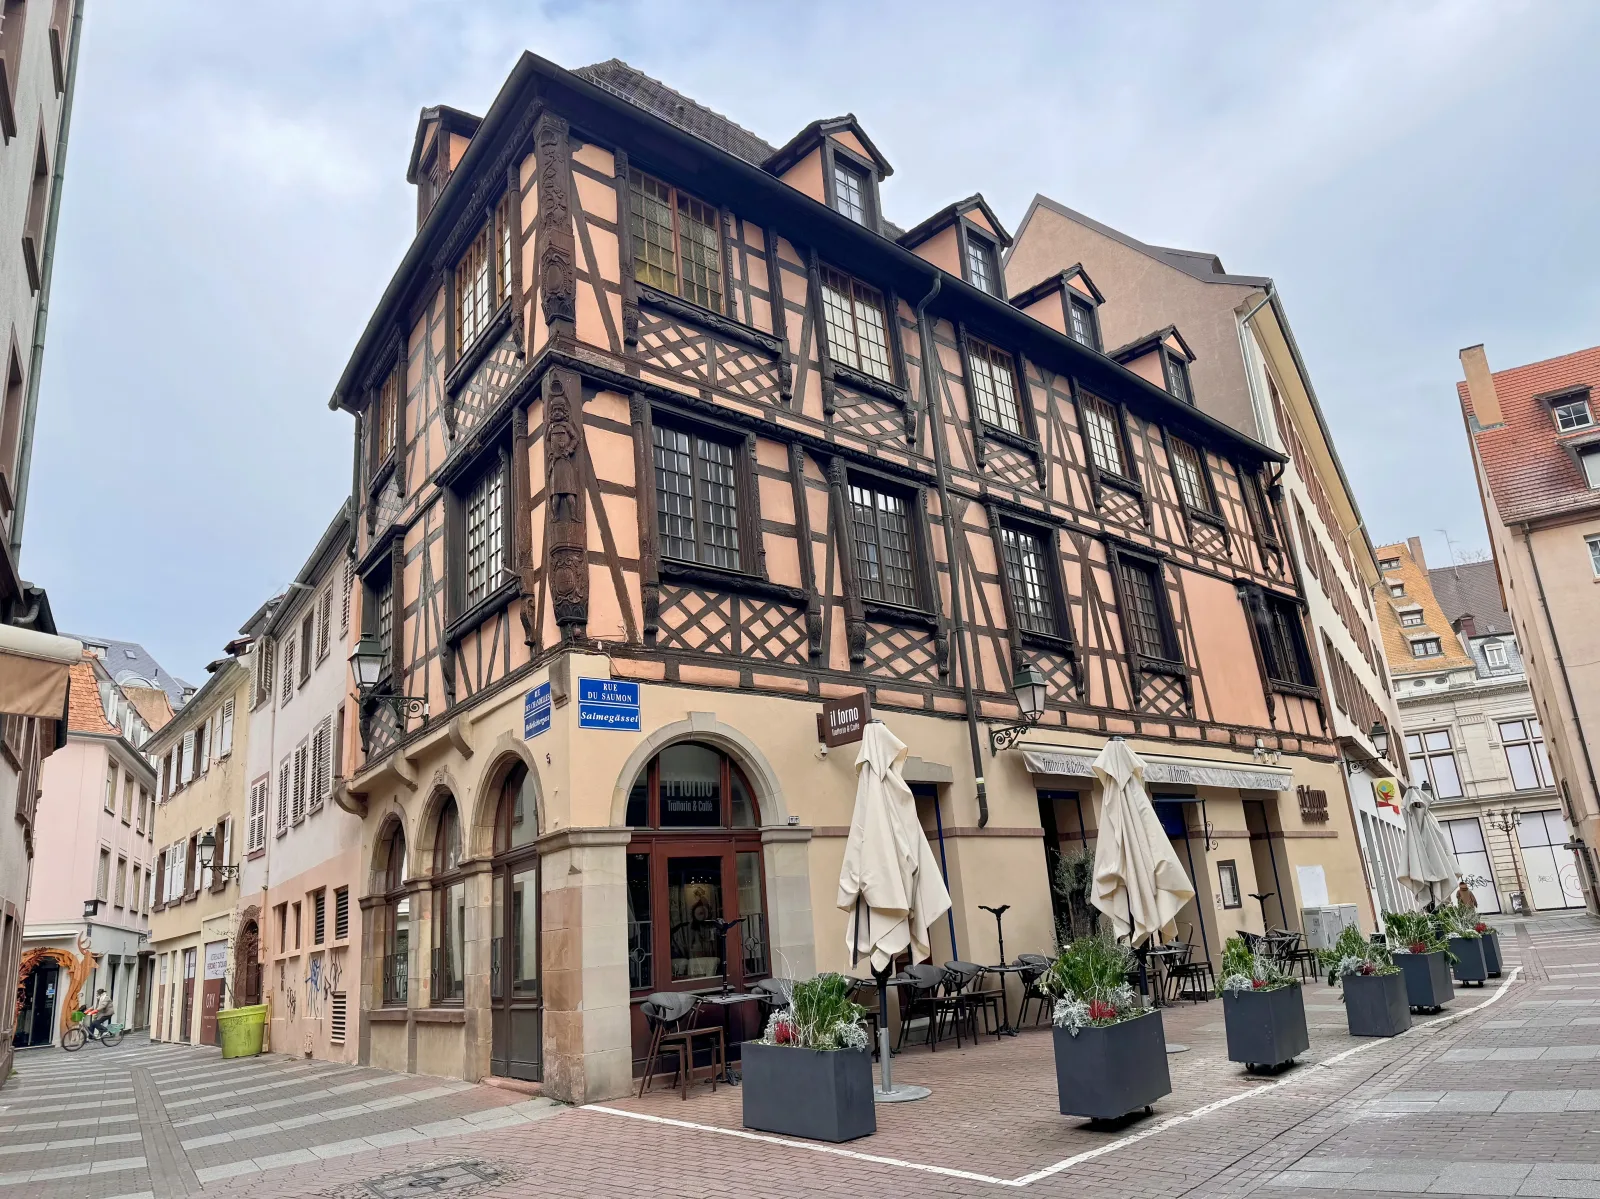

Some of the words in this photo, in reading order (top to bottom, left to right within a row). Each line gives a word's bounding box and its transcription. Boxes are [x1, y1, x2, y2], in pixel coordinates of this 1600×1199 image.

[603, 683, 618, 691] RUE
[587, 691, 598, 700] DU
[601, 692, 632, 702] SAUMON
[580, 711, 639, 723] Salmegässel
[830, 710, 836, 727] il
[838, 707, 859, 725] forno
[667, 800, 692, 812] Trattoria
[692, 800, 698, 812] &
